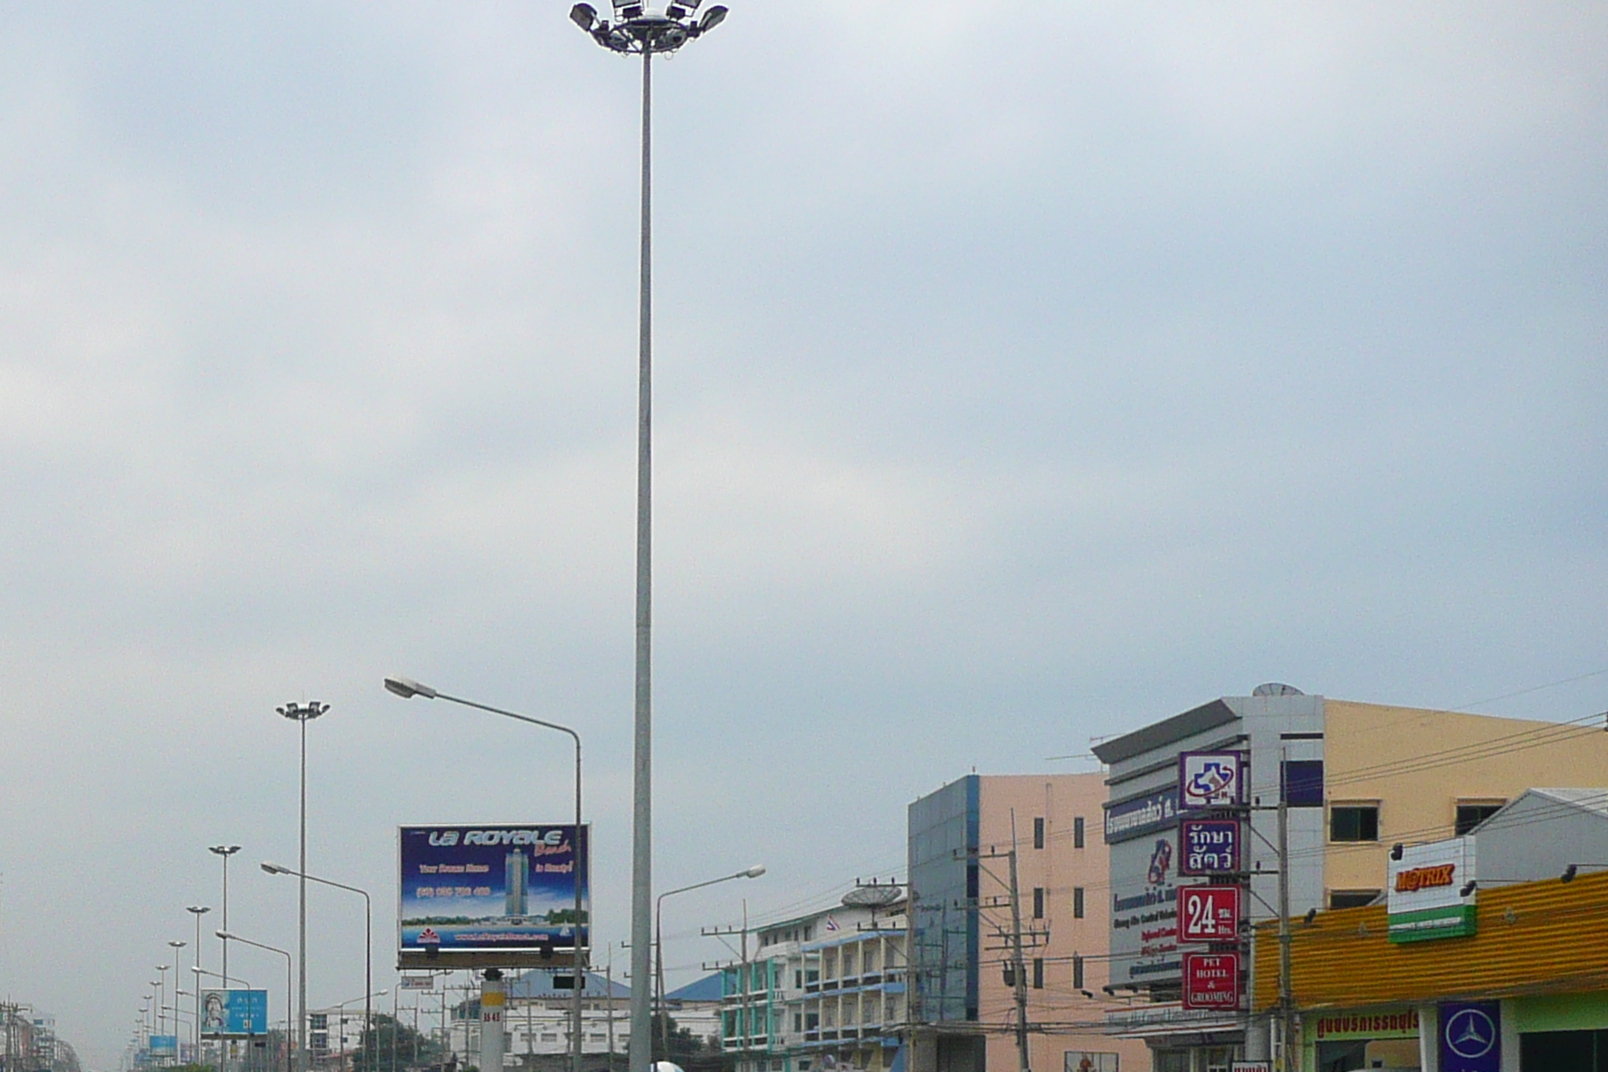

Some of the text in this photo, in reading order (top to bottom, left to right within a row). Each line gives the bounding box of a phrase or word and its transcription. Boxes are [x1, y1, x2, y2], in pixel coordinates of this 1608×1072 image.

[1189, 824, 1233, 844] รักษา
[1189, 845, 1233, 869] สัตว์
[1188, 894, 1217, 934] 24
[1203, 958, 1222, 967] PET
[1196, 969, 1228, 979] HOTEL
[1190, 991, 1234, 1003] GROOMING
